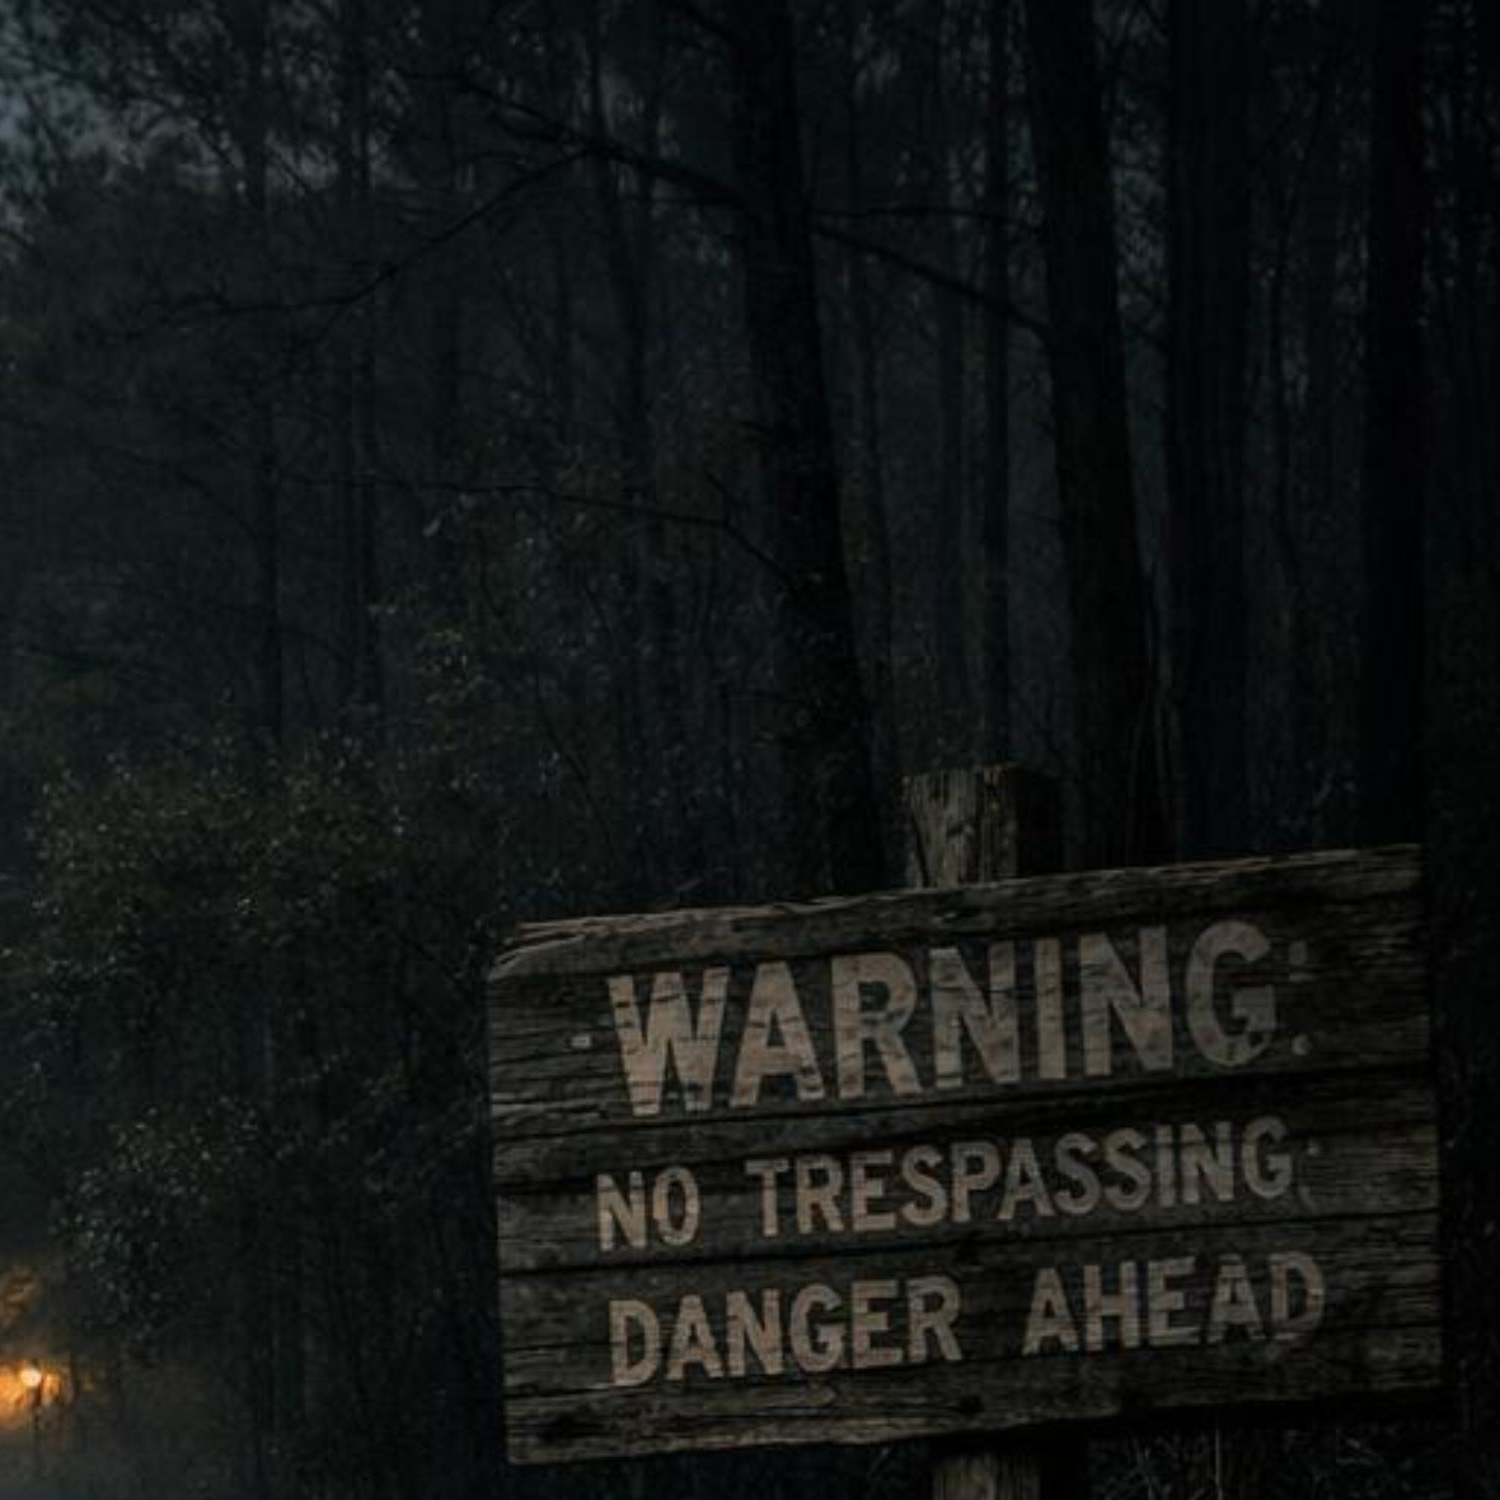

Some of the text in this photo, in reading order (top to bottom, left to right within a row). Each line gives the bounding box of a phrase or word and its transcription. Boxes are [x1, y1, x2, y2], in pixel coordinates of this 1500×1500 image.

[596, 1168, 701, 1252] NO
[609, 1252, 1327, 1389] DANGER AHEAD
